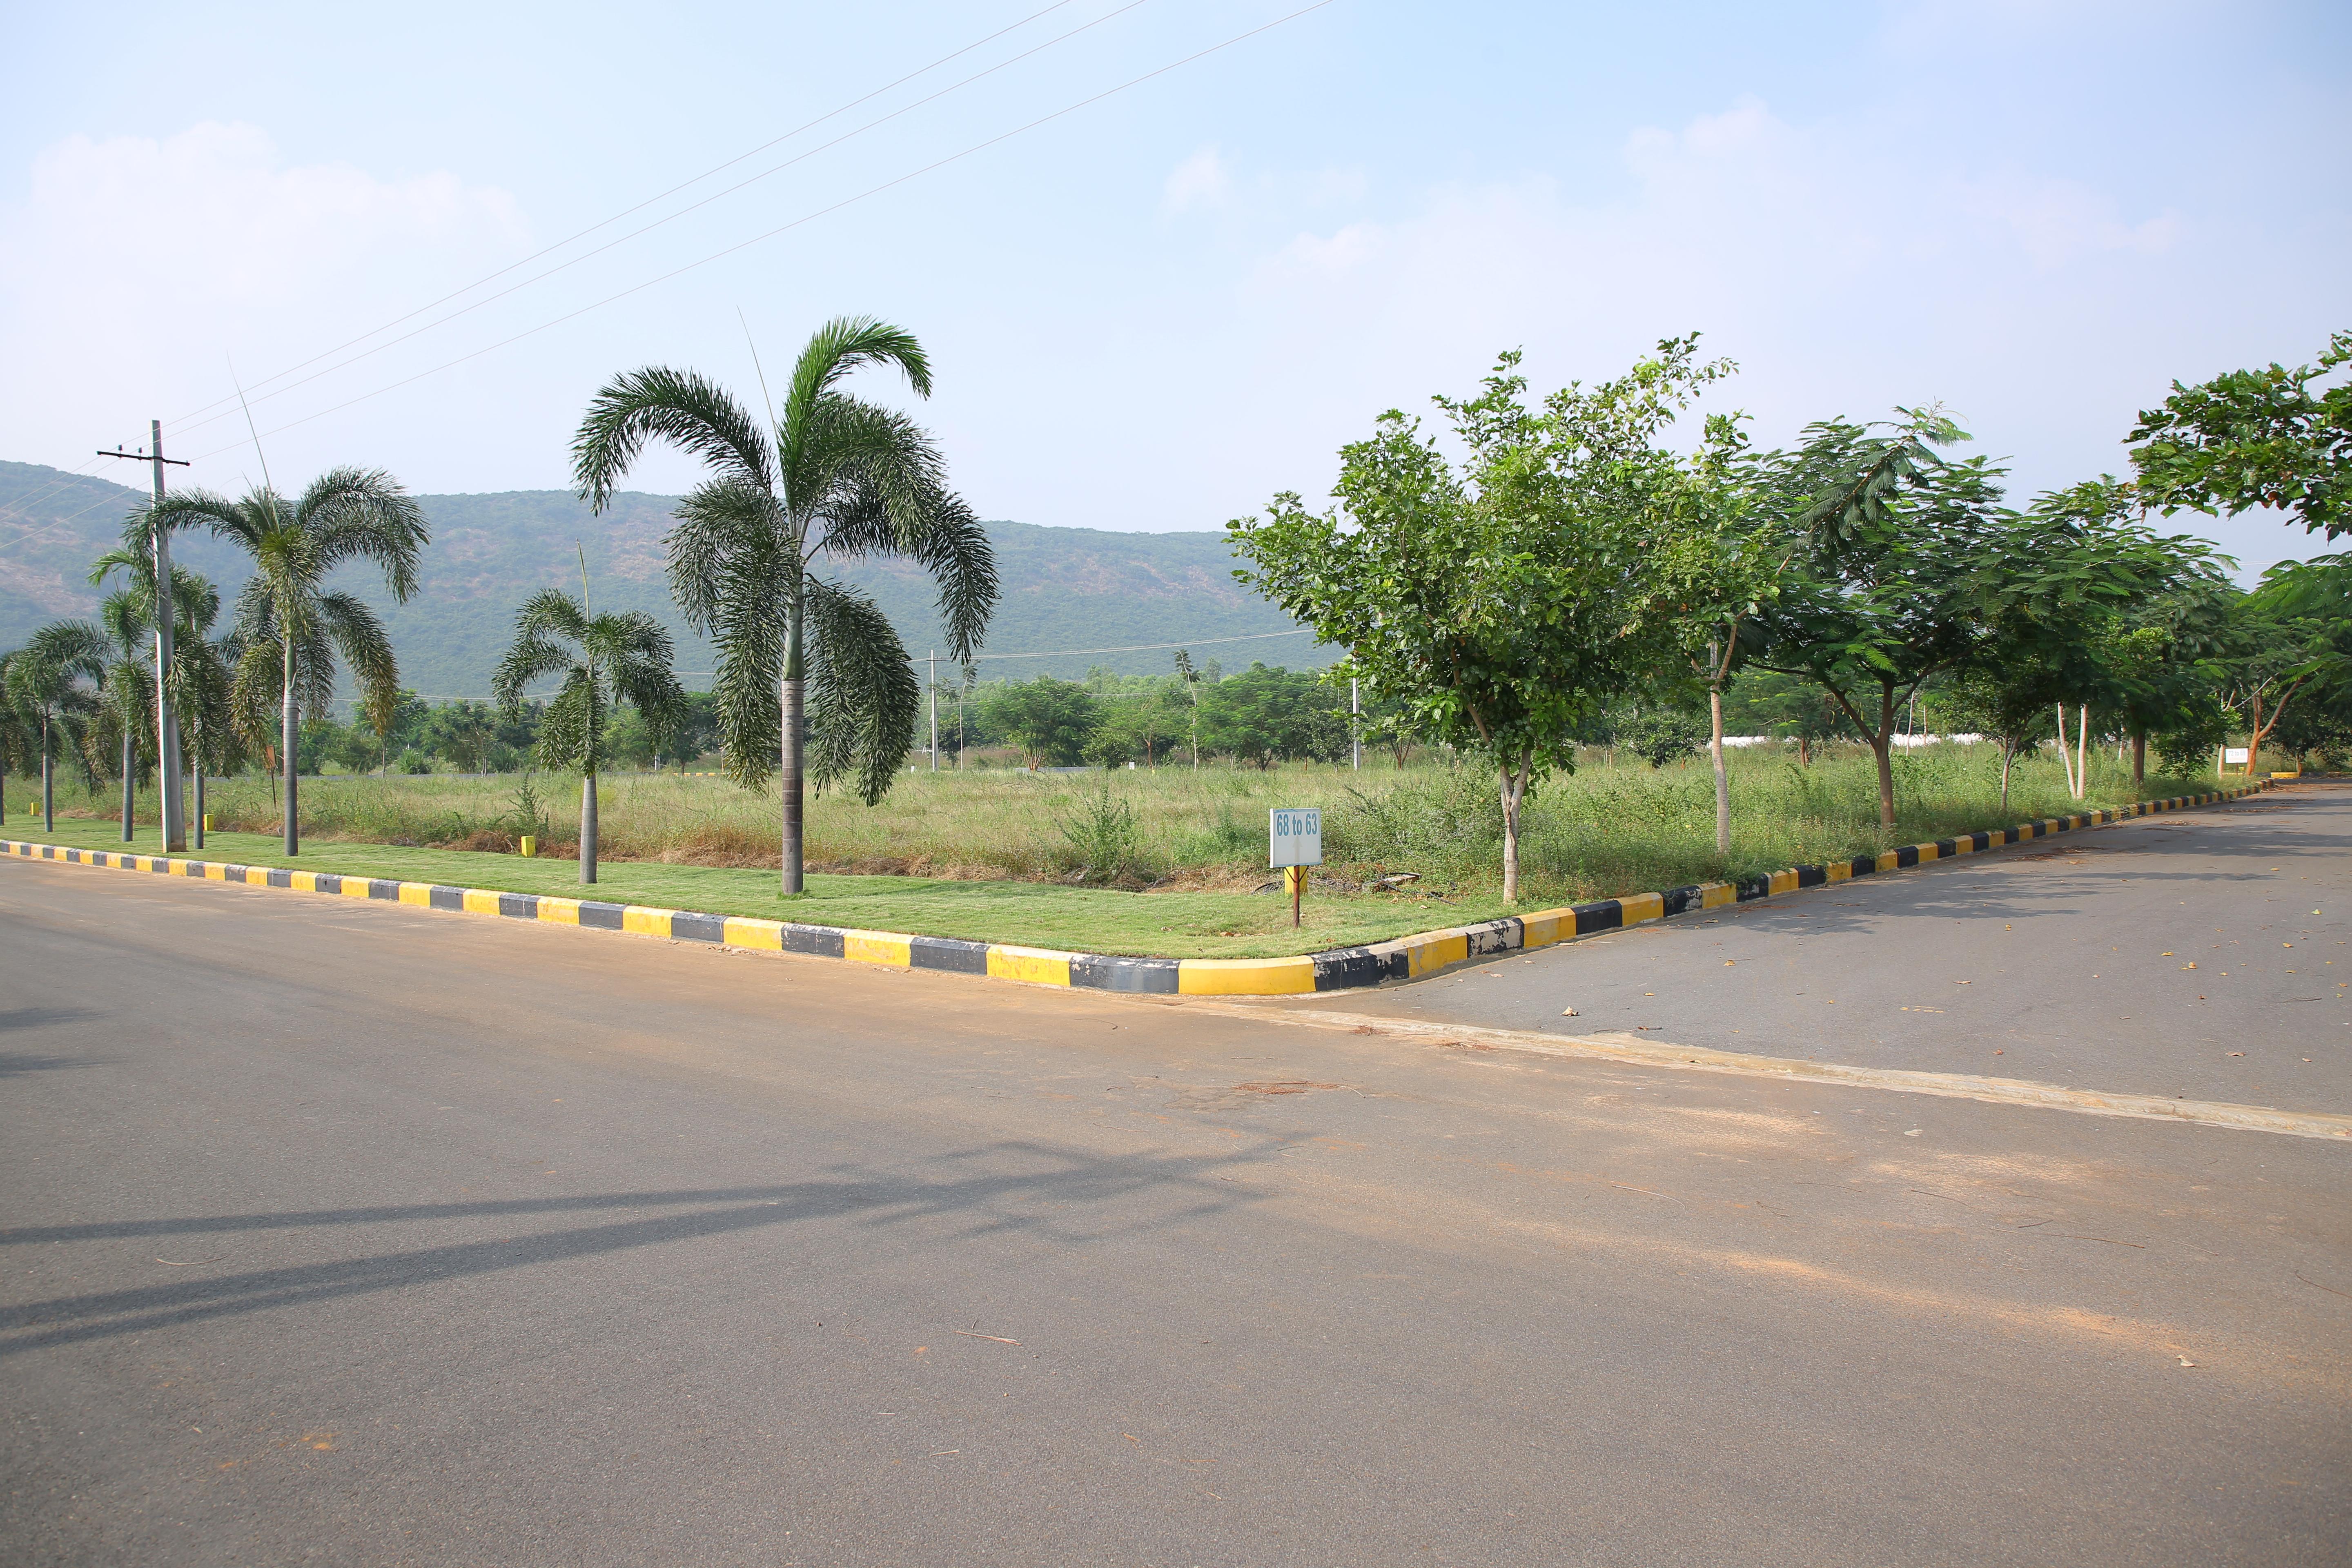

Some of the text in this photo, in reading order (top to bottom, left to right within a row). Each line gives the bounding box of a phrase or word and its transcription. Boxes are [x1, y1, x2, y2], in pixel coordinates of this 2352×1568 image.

[1277, 813, 1317, 836] 68 to 63
